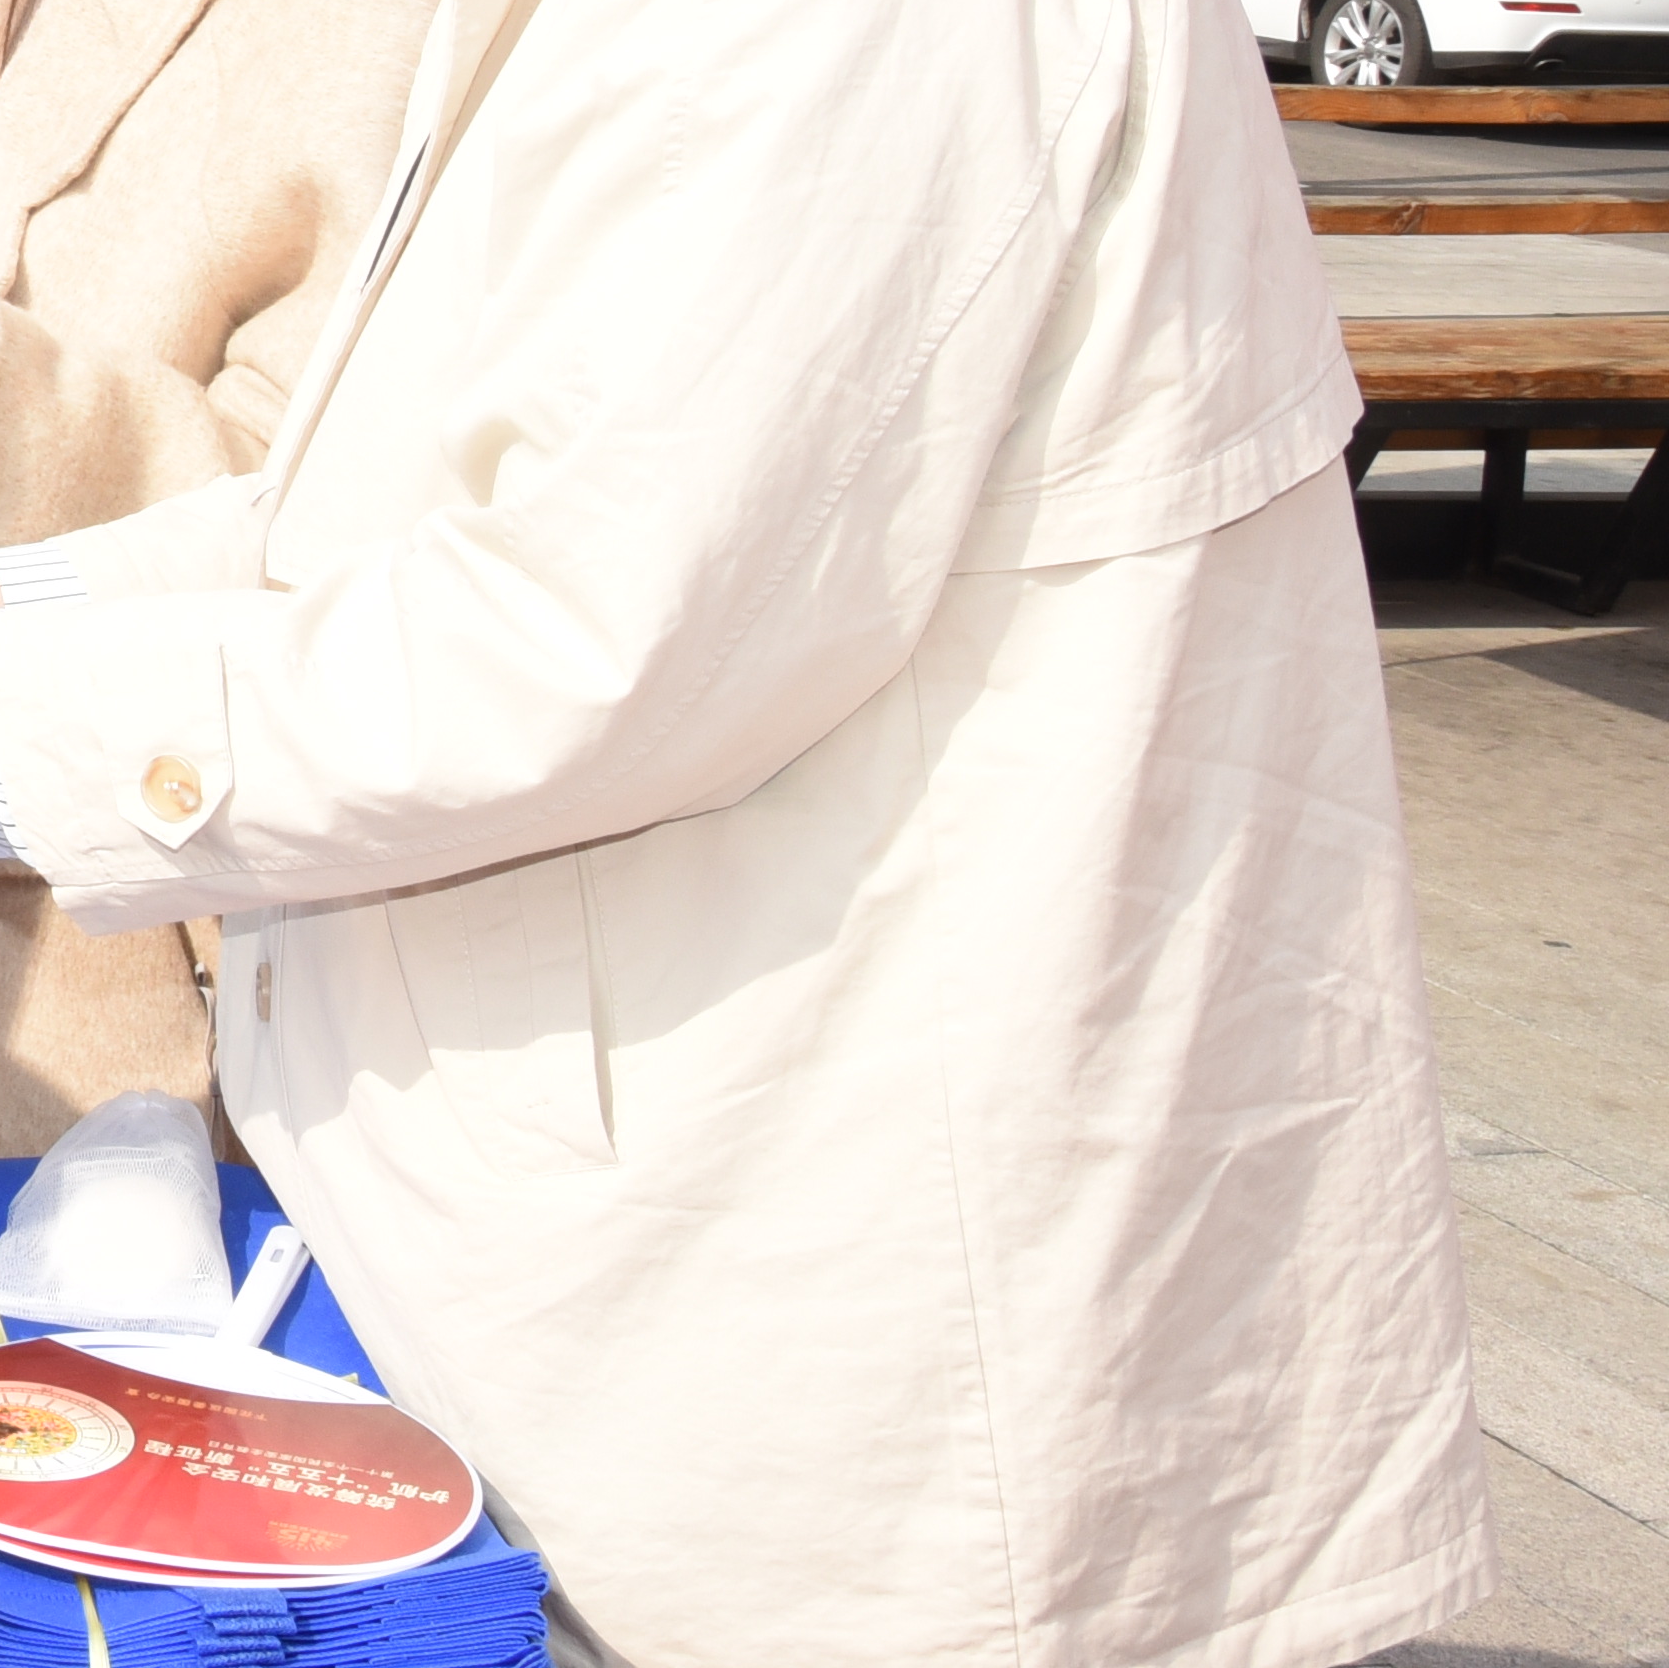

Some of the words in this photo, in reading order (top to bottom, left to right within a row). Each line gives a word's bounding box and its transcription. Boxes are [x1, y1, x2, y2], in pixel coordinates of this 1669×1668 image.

[182, 1461, 397, 1511] 统筹发展和安全
